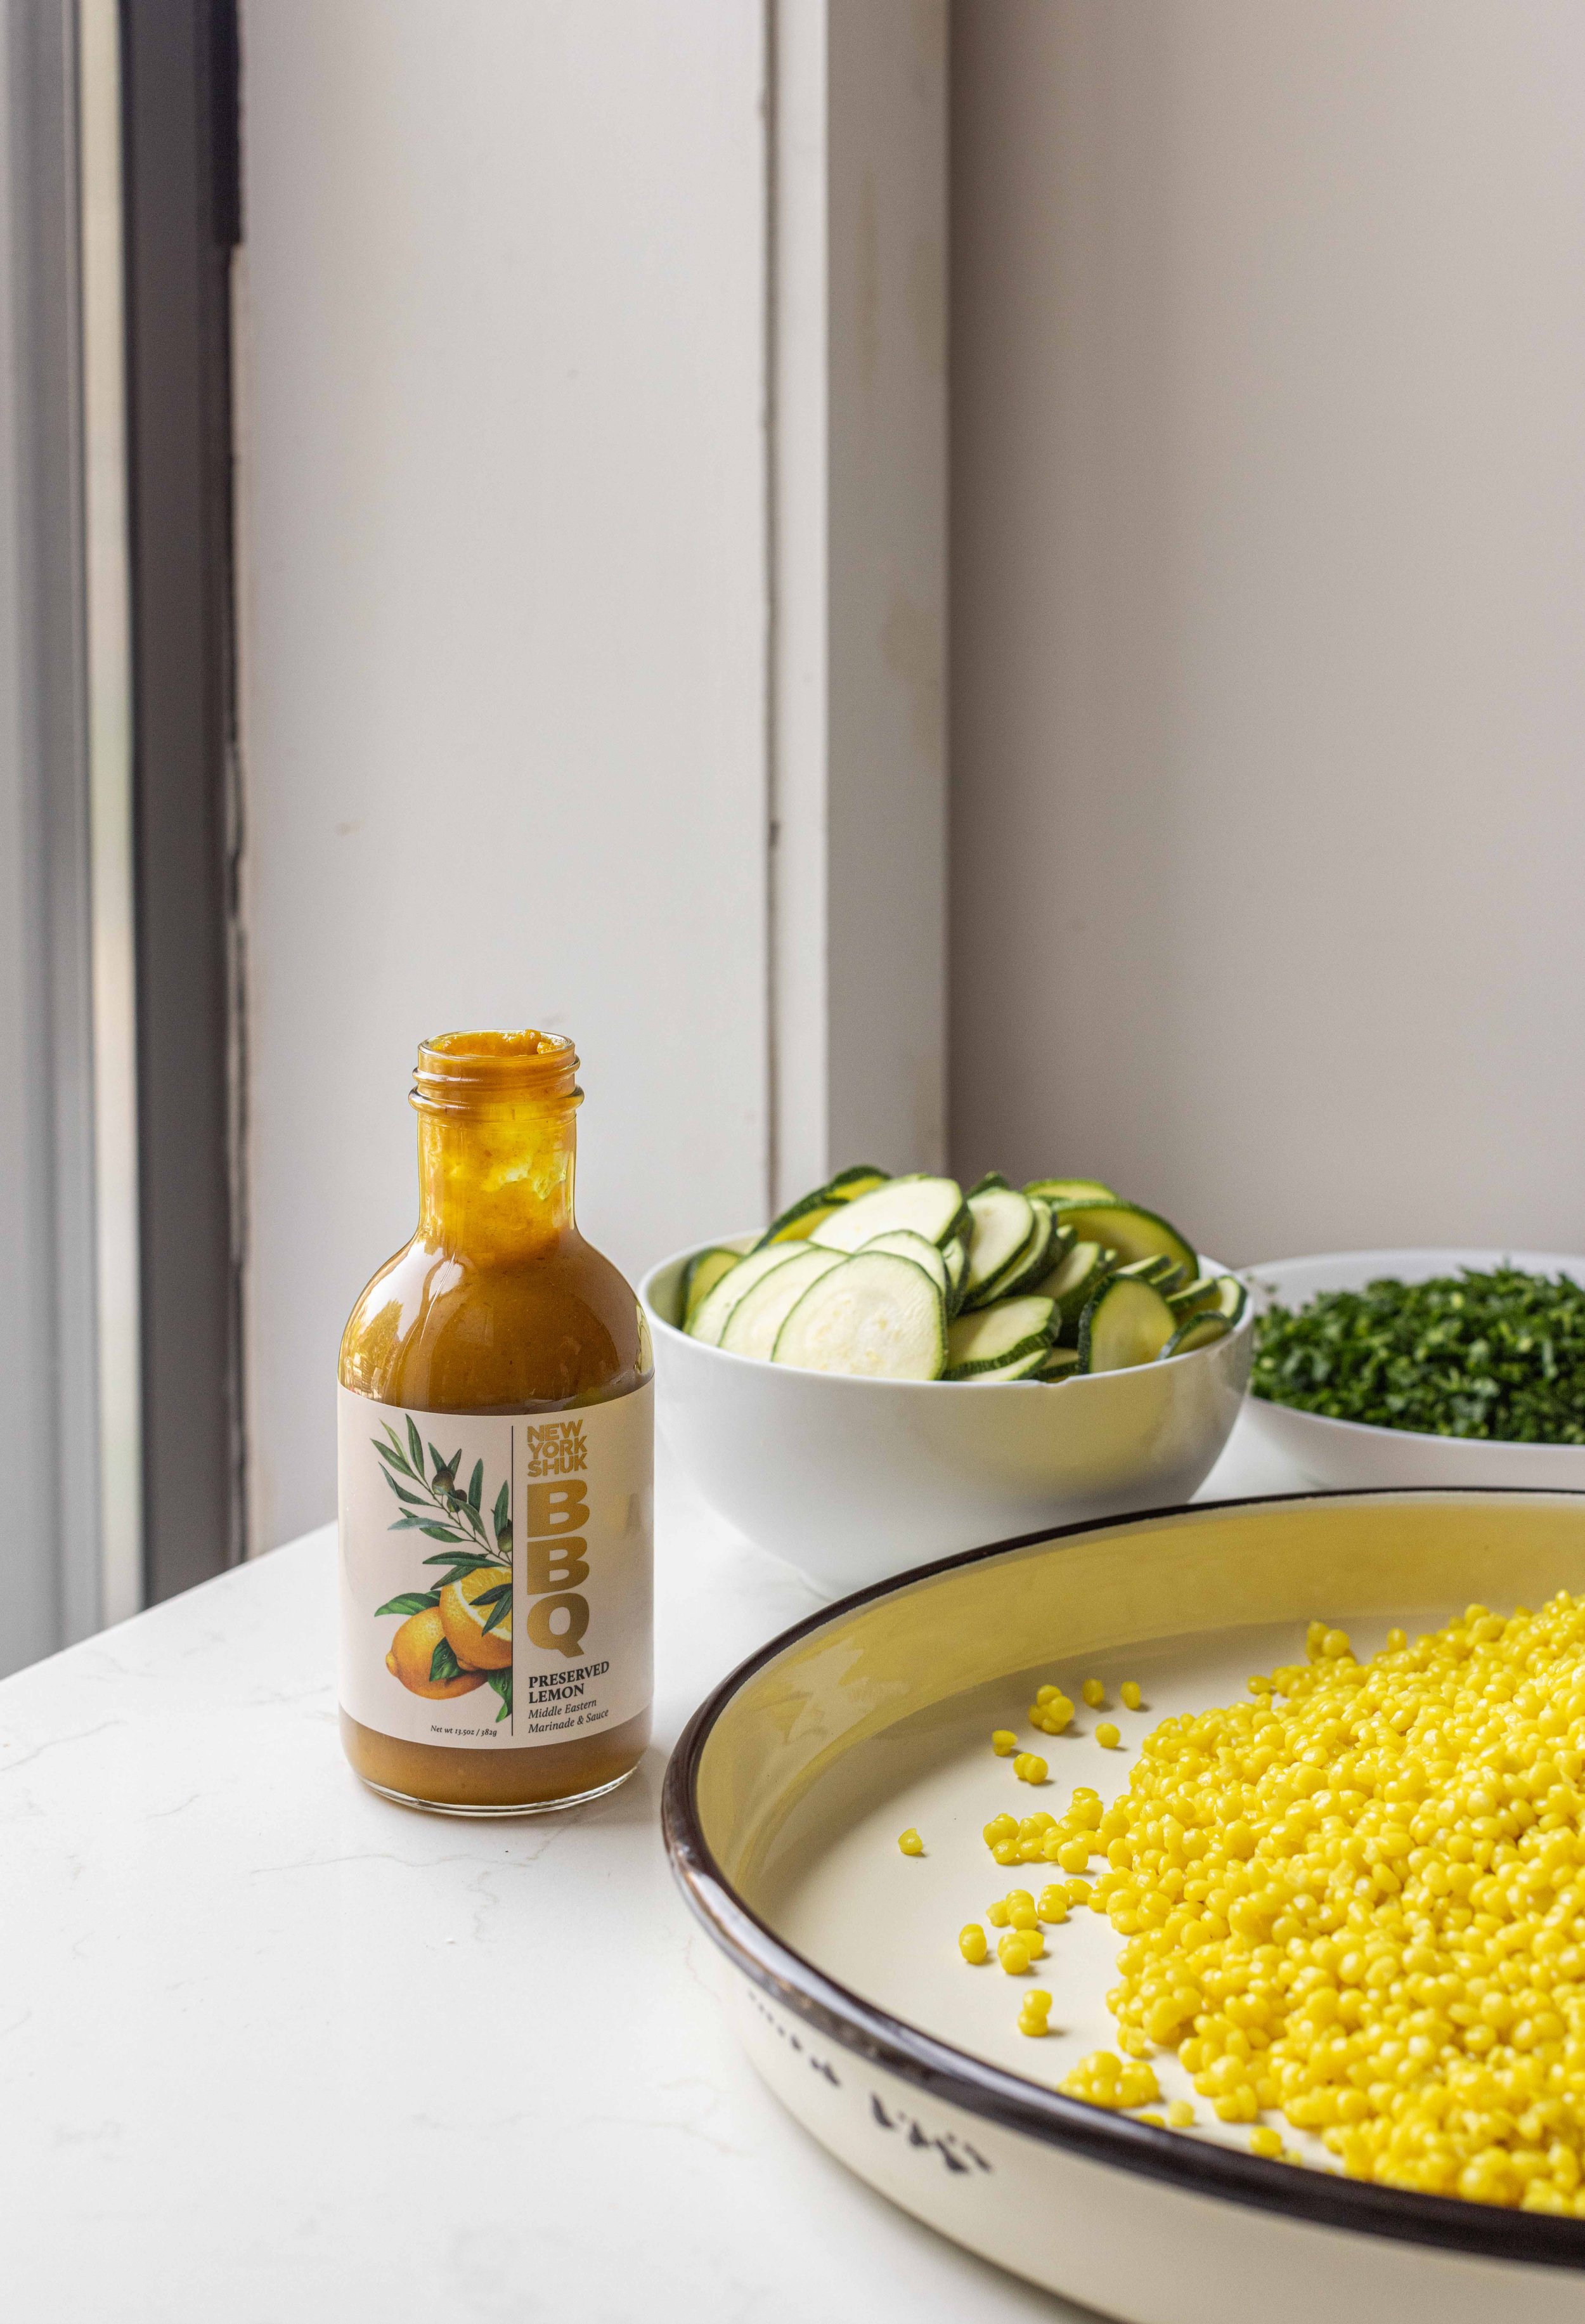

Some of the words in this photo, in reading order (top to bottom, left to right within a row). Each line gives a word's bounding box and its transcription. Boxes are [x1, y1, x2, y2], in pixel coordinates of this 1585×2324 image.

[527, 1420, 583, 1443] NEW
[527, 1436, 587, 1460] YORK
[527, 1453, 588, 1477] SHUK
[527, 1479, 590, 1658] BBQ
[529, 1661, 609, 1688] PRESERVED
[529, 1684, 584, 1703] LEMON
[528, 1706, 562, 1718] Middle
[565, 1699, 597, 1713] Eastern
[430, 1725, 443, 1733] Net
[481, 1729, 497, 1737] 382g
[528, 1718, 574, 1733] Marinade
[577, 1715, 584, 1725] &
[586, 1710, 609, 1723] Sauce
